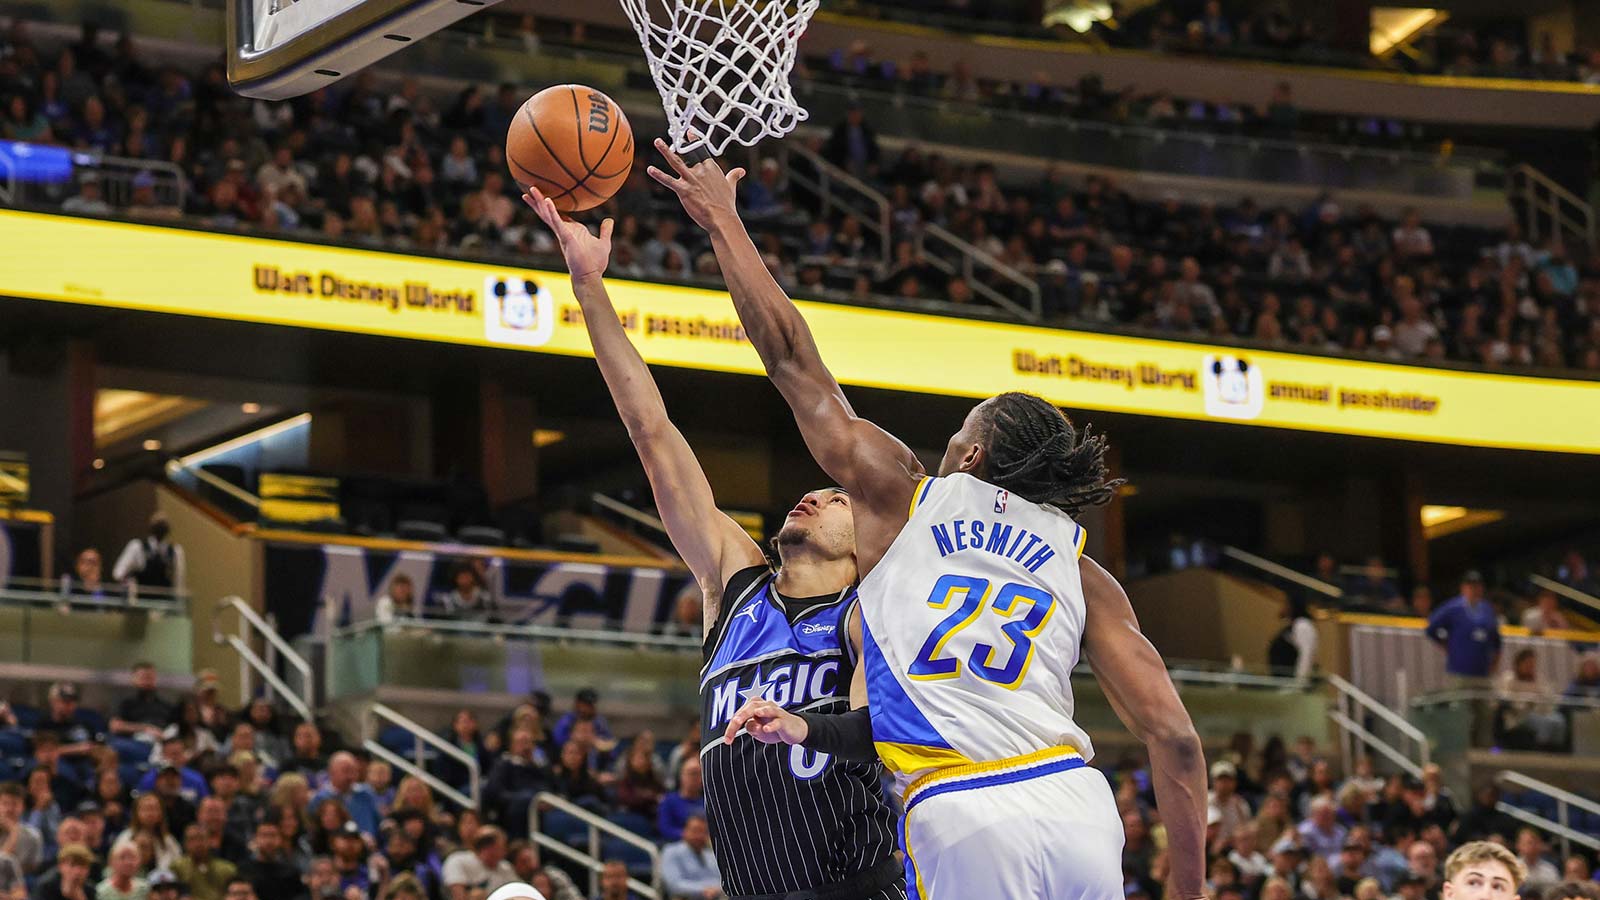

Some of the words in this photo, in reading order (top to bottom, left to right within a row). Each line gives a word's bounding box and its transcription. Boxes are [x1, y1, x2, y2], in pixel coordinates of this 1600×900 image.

[254, 266, 313, 295] Walt
[319, 273, 400, 311] Disney
[404, 283, 474, 313] World
[562, 307, 638, 330] anal
[1069, 356, 1134, 387] Disney
[1138, 364, 1196, 390] World
[1268, 382, 1331, 403] annual
[1339, 390, 1438, 413] passholder
[930, 519, 1055, 574] NESMITH
[801, 622, 837, 635] Disney
[907, 574, 1057, 691] 23
